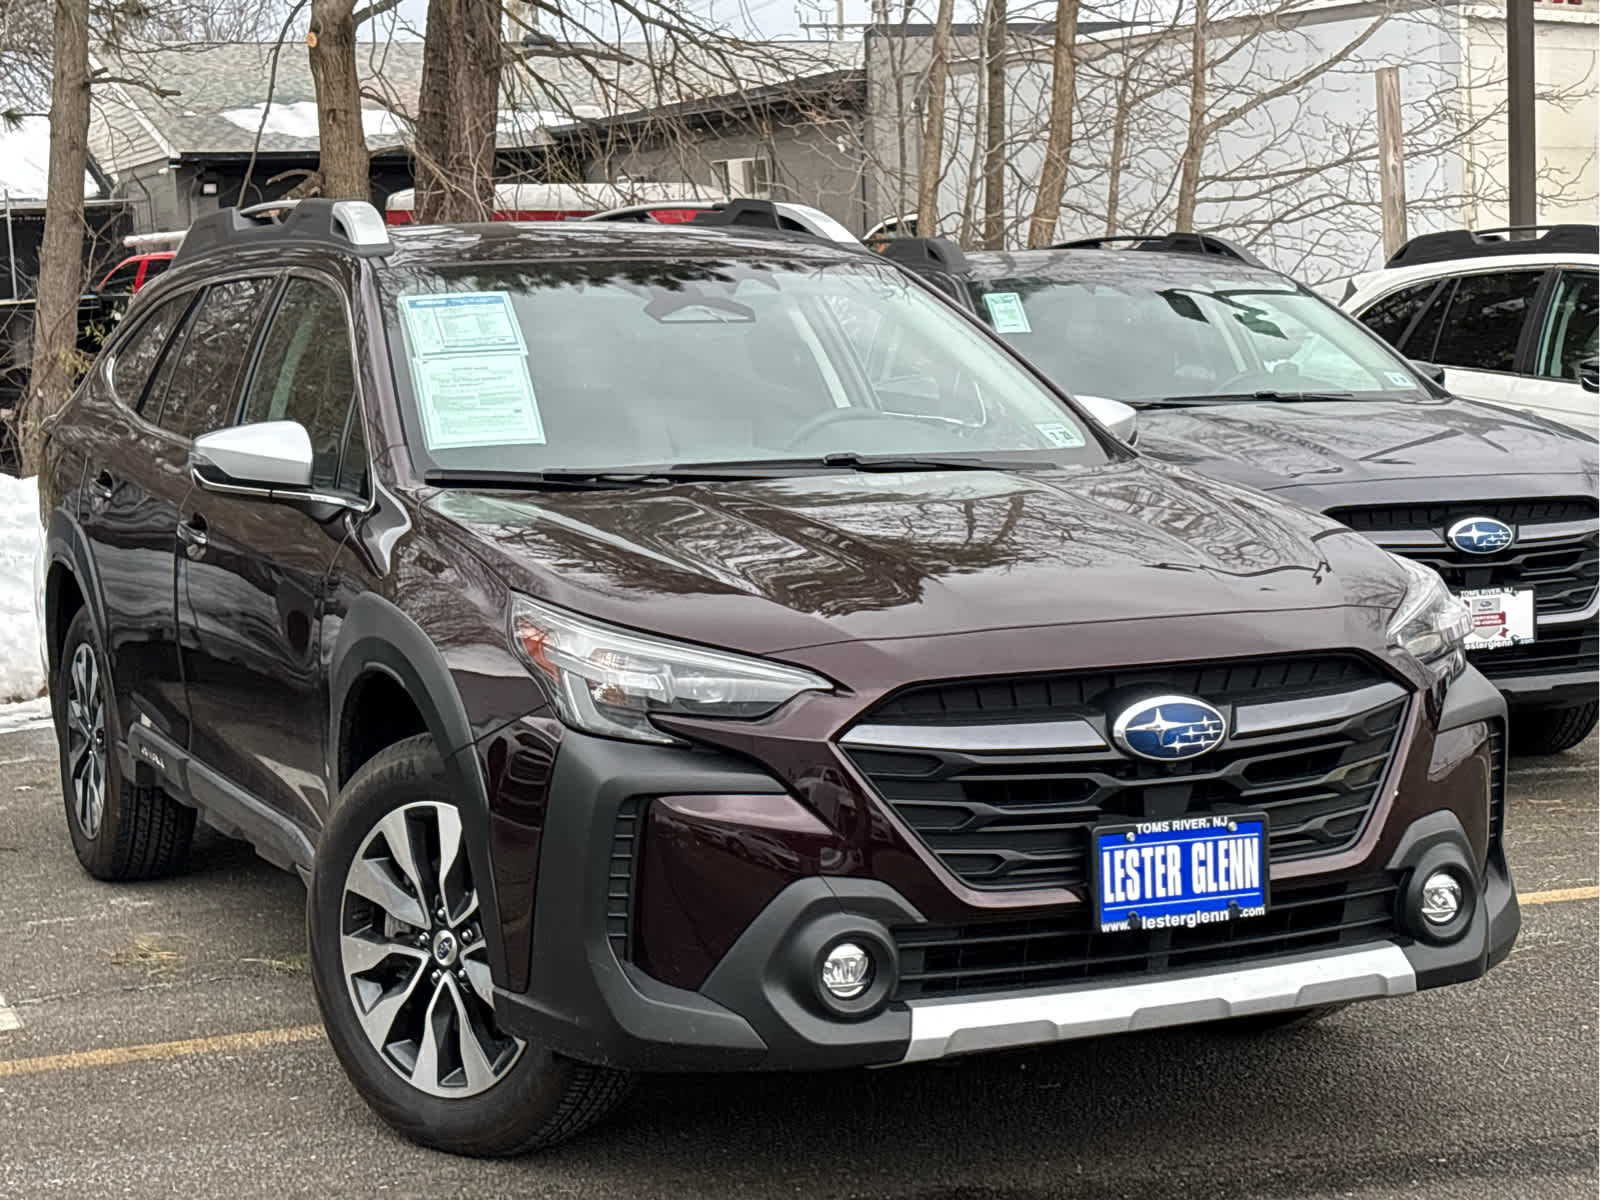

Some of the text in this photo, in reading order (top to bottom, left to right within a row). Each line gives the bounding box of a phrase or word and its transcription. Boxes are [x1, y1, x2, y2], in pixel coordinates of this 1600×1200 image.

[1135, 816, 1228, 834] TOMS RIVER, NJ
[1102, 837, 1260, 903] LESTER GLENN
[1141, 909, 1229, 930] lesterglenn
[1239, 906, 1265, 917] .com
